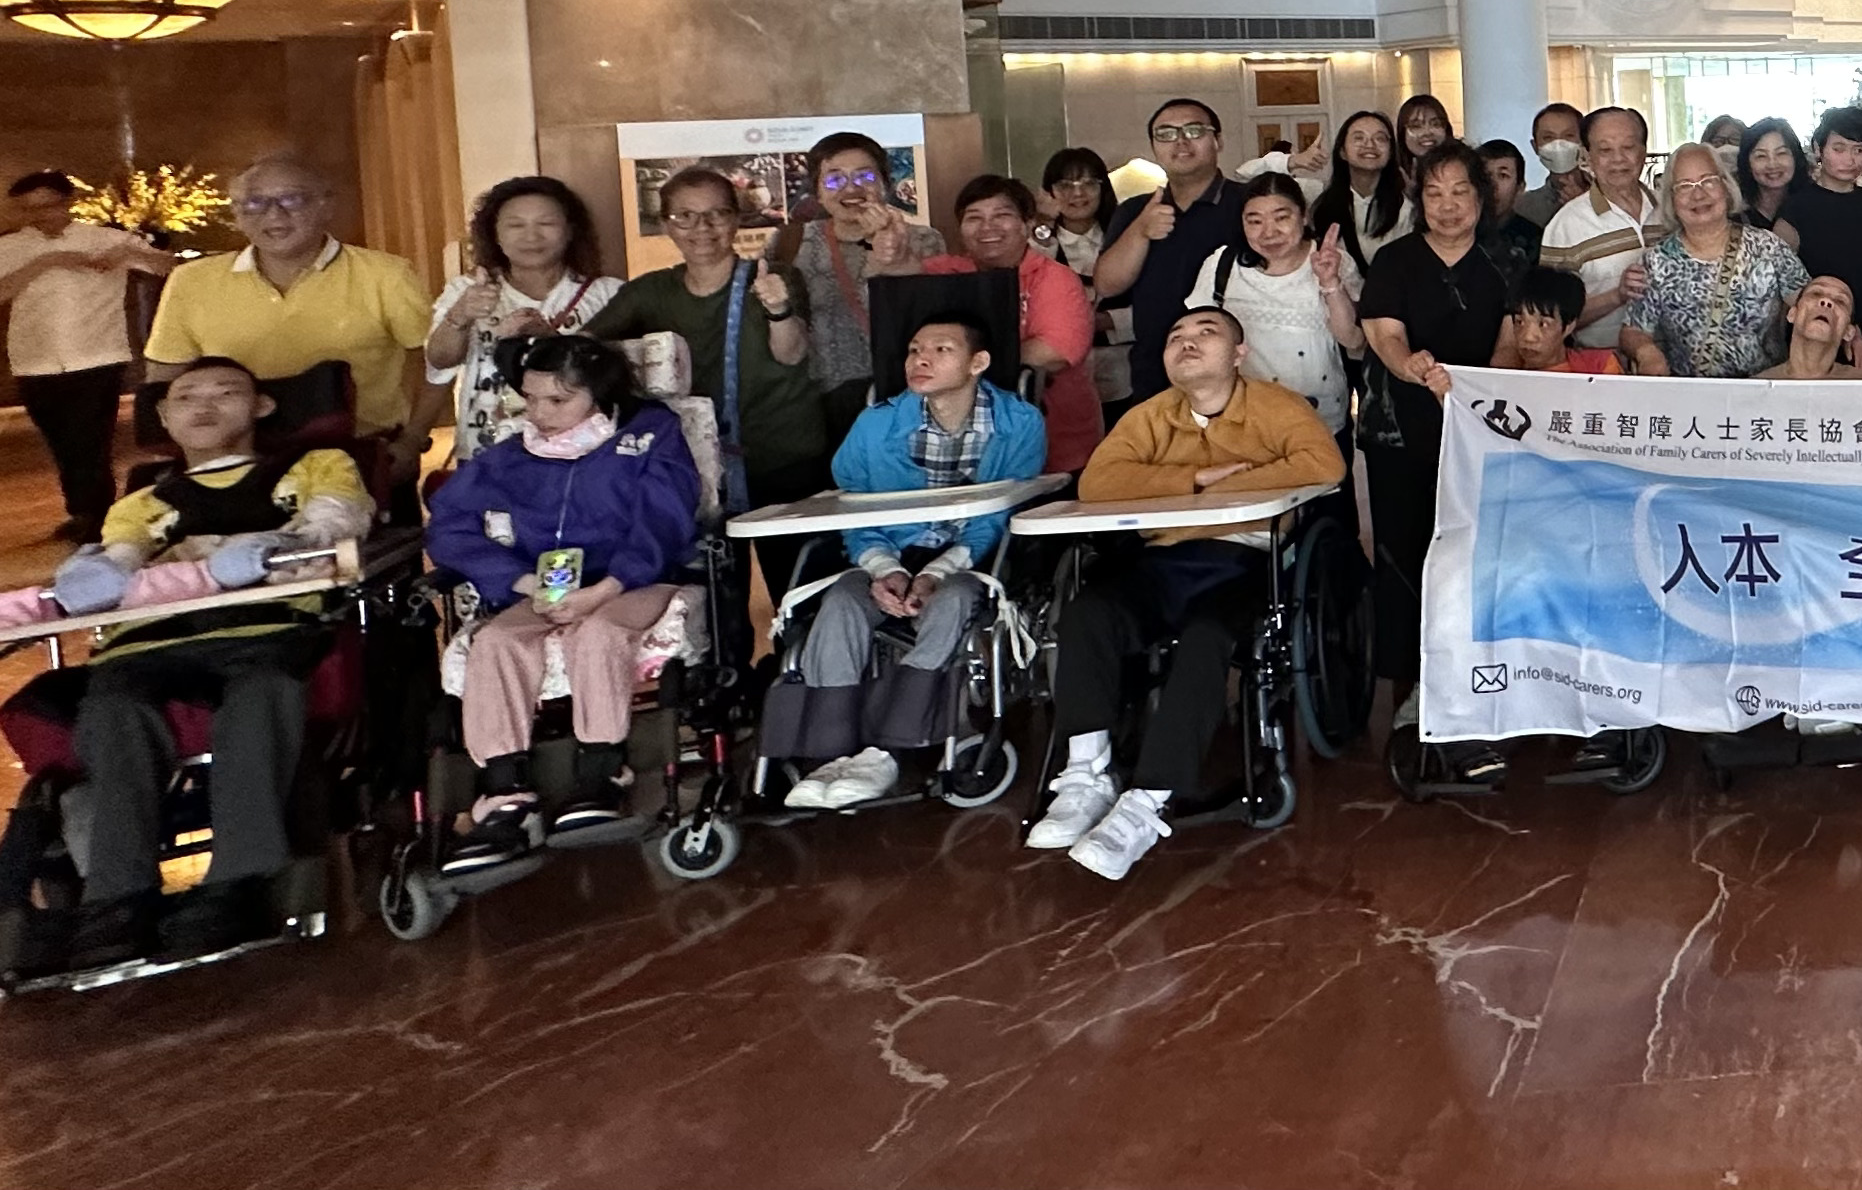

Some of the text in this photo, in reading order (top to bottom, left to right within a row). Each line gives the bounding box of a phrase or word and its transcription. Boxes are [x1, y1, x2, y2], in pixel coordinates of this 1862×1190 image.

[1720, 237, 1740, 286] SALAD
[1714, 294, 1725, 310] IS
[1567, 439, 1632, 456] Association
[1635, 445, 1649, 457] of
[1649, 446, 1688, 462] Family
[1691, 448, 1727, 461] Carers
[1730, 448, 1745, 461] of
[1745, 448, 1793, 464] Severely
[1660, 523, 1783, 597] 人本
[1513, 665, 1642, 704] info@sid-carers.org
